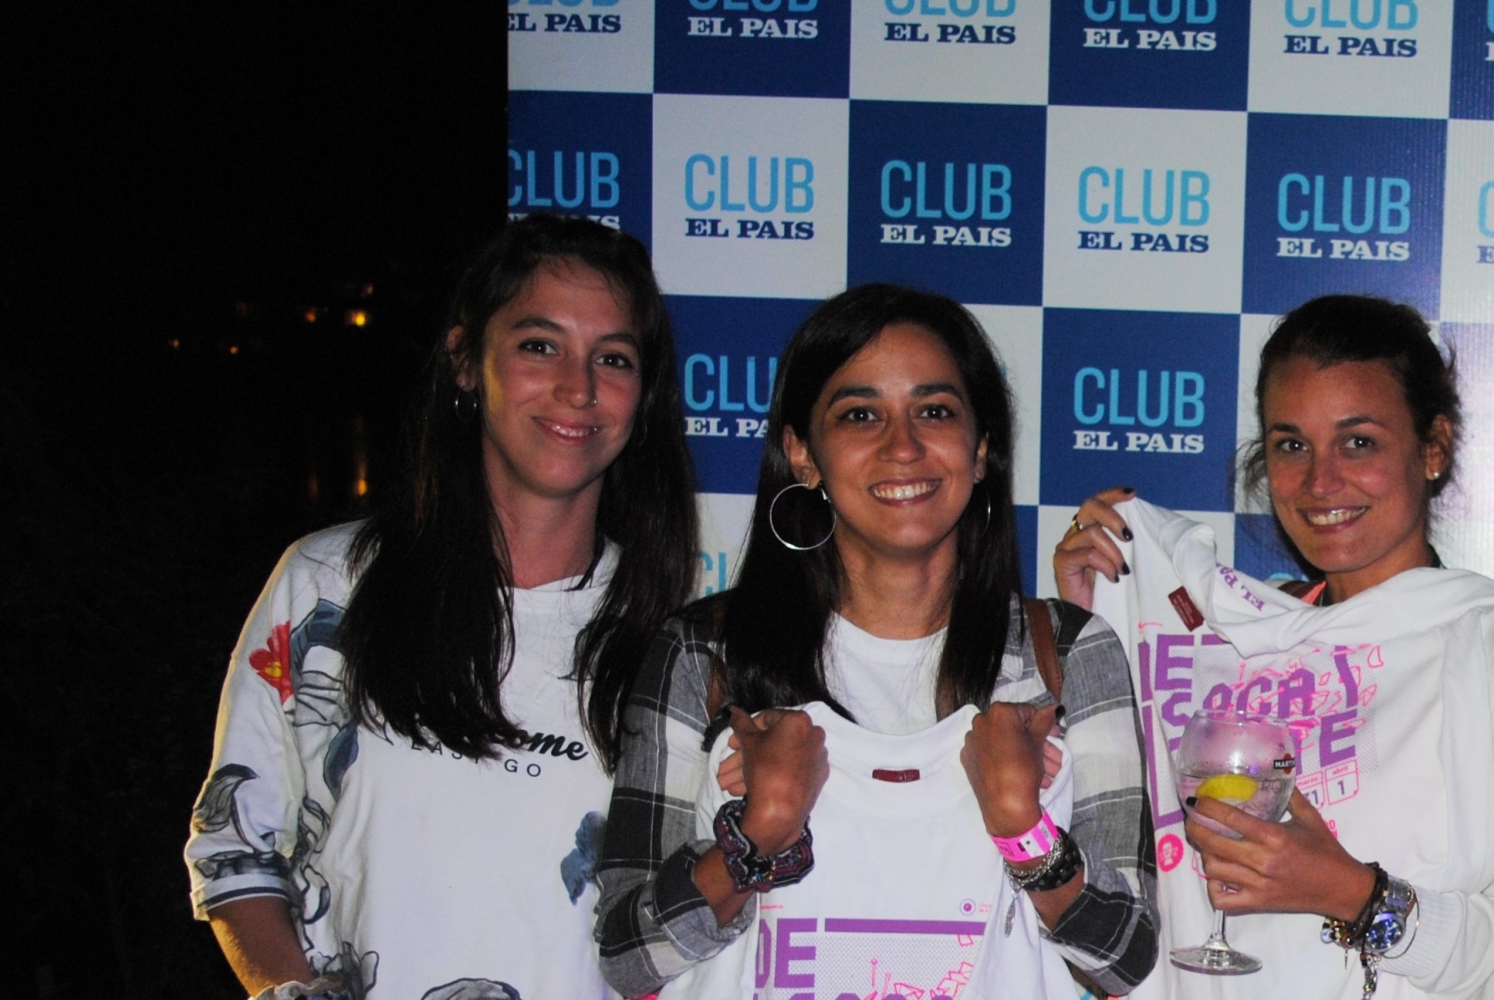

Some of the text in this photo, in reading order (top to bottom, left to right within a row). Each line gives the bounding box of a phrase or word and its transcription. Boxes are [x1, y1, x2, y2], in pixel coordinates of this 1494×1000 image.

[544, 14, 621, 34] PAIS
[687, 17, 819, 40] EL PAIS
[884, 23, 1016, 45] EL PAIS
[1083, 28, 1217, 52] EL PAIS
[1283, 34, 1418, 58] EL PAIS
[684, 153, 815, 214] CLUB
[880, 159, 1013, 220] CLUB
[1077, 165, 1211, 227] CLUB
[1277, 172, 1412, 235] CLUB
[685, 218, 815, 241] EL PAIS
[880, 223, 1012, 247] EL PAIS
[1077, 230, 1210, 254] EL PAIS
[1276, 236, 1410, 262] EL PAIS
[684, 353, 778, 413] CLU
[1072, 366, 1206, 429] CLUB
[684, 416, 729, 437] EL
[1073, 430, 1205, 454] EL PAIS
